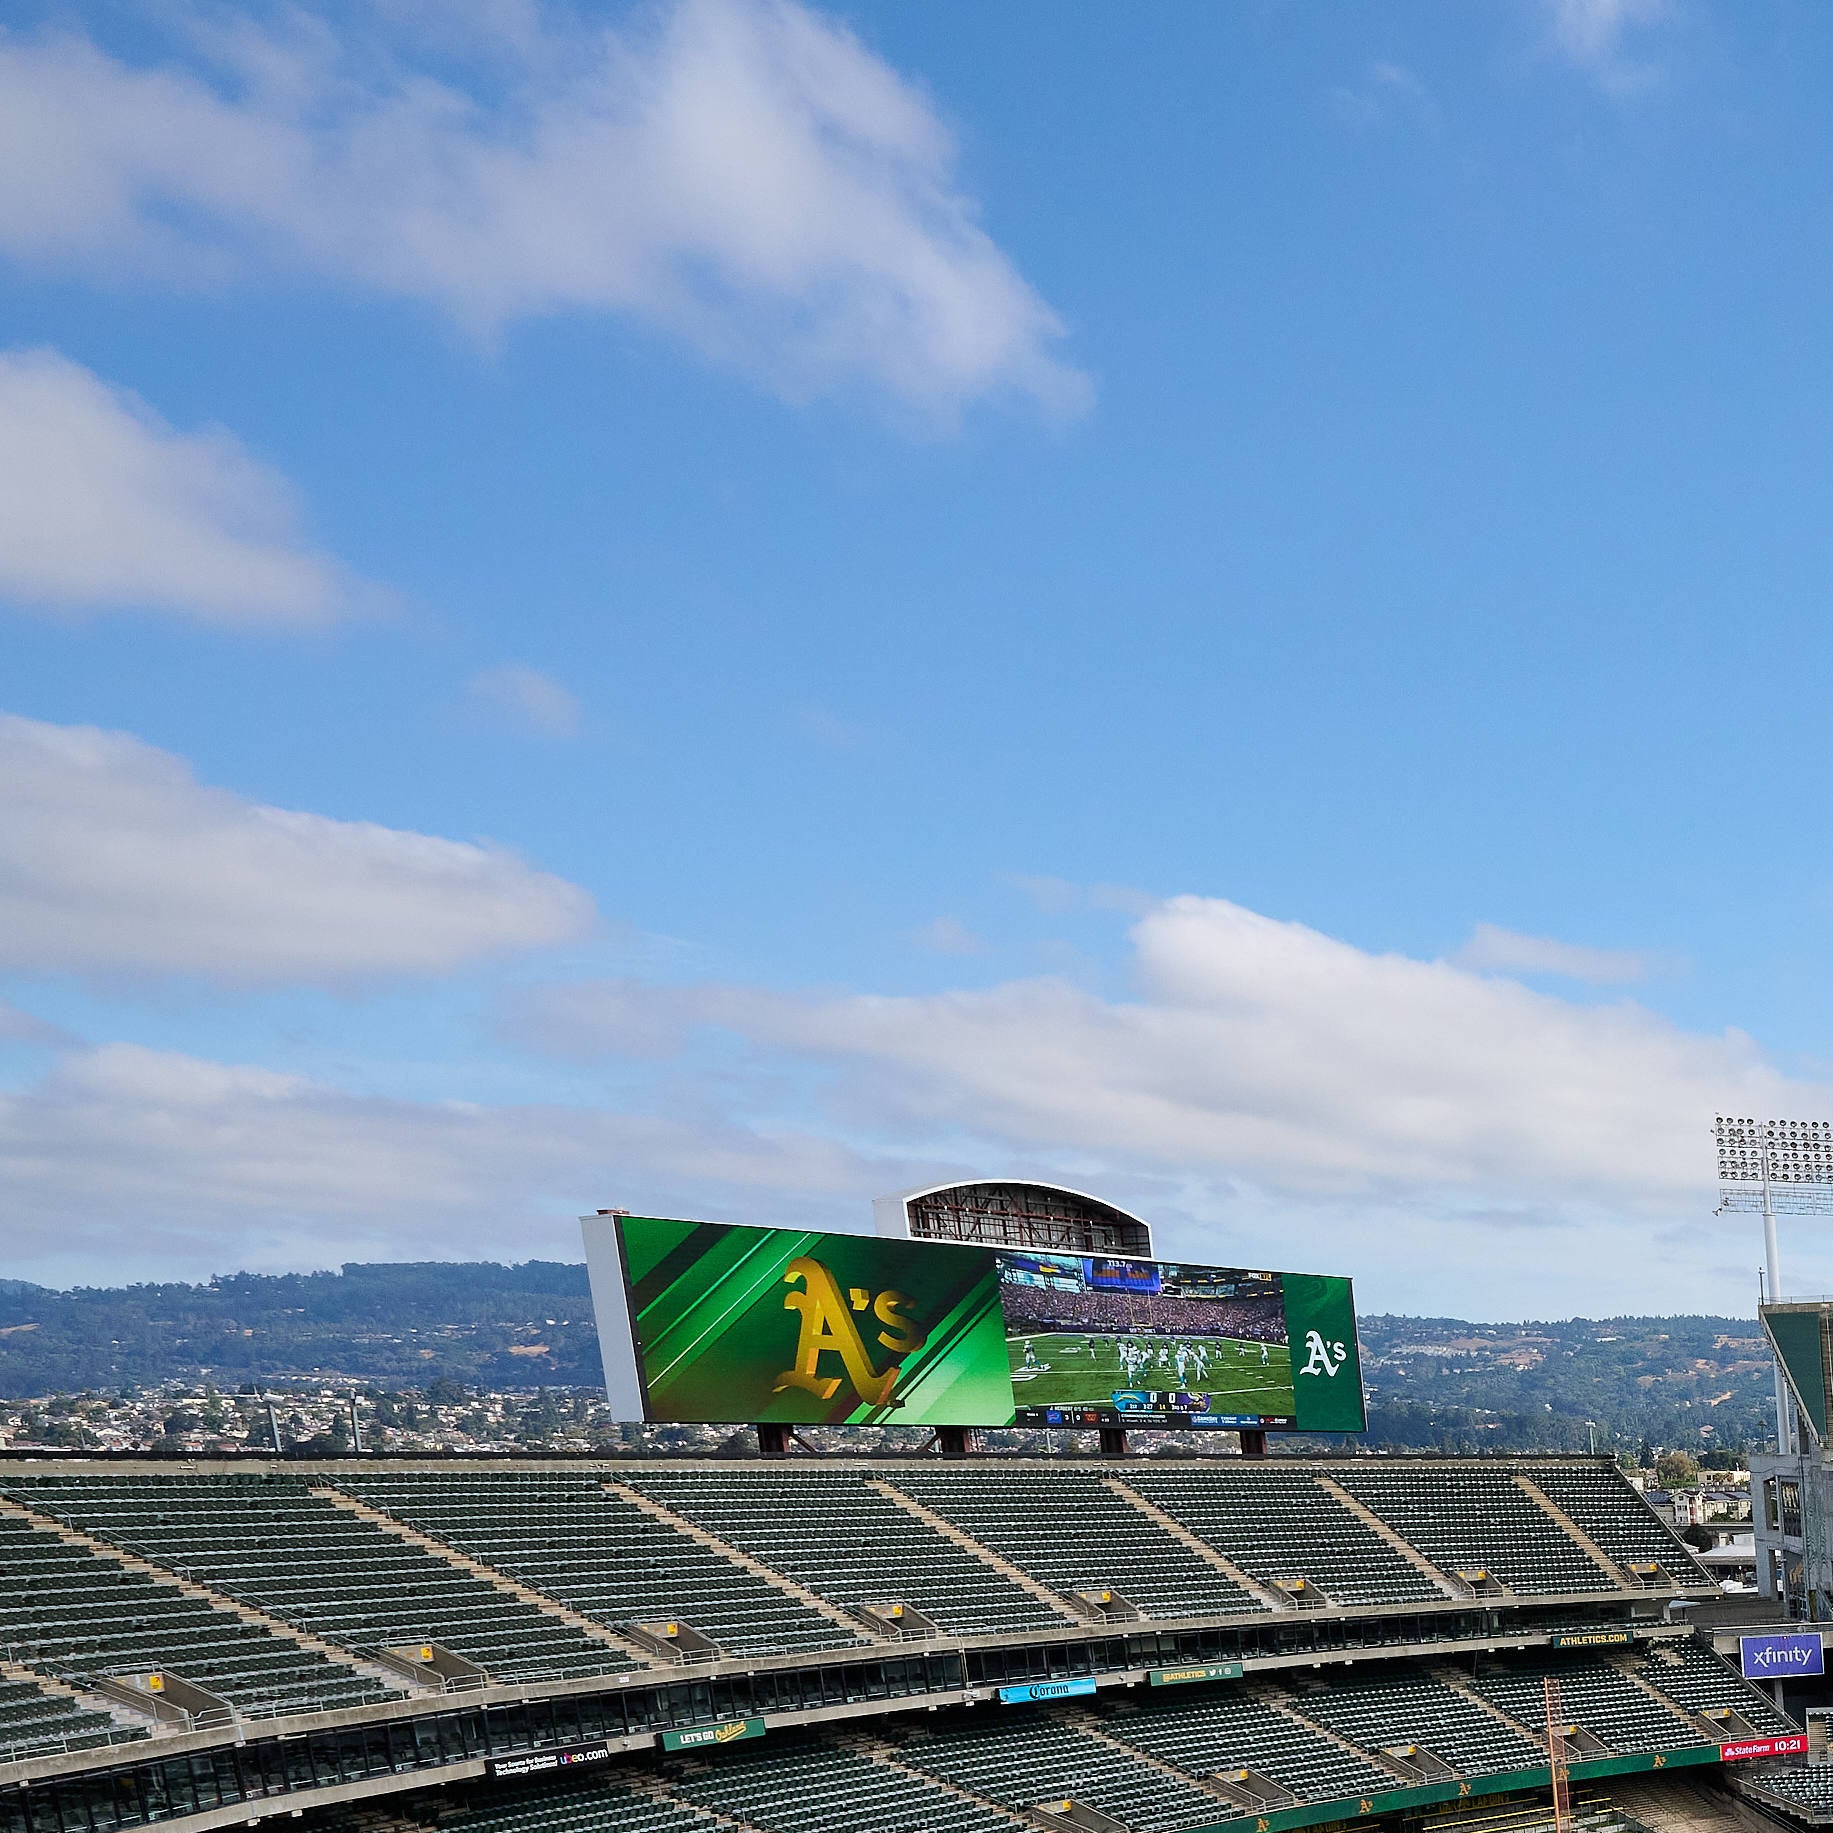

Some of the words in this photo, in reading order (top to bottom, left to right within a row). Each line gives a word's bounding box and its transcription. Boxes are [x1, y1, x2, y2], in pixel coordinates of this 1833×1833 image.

[773, 1256, 925, 1408] A's
[1300, 1330, 1347, 1377] A's
[1753, 1646, 1812, 1668] xfinity
[1029, 1683, 1069, 1699] Corona
[680, 1731, 702, 1745] LET'S
[702, 1730, 714, 1742] GO
[1774, 1739, 1801, 1752] 10:21
